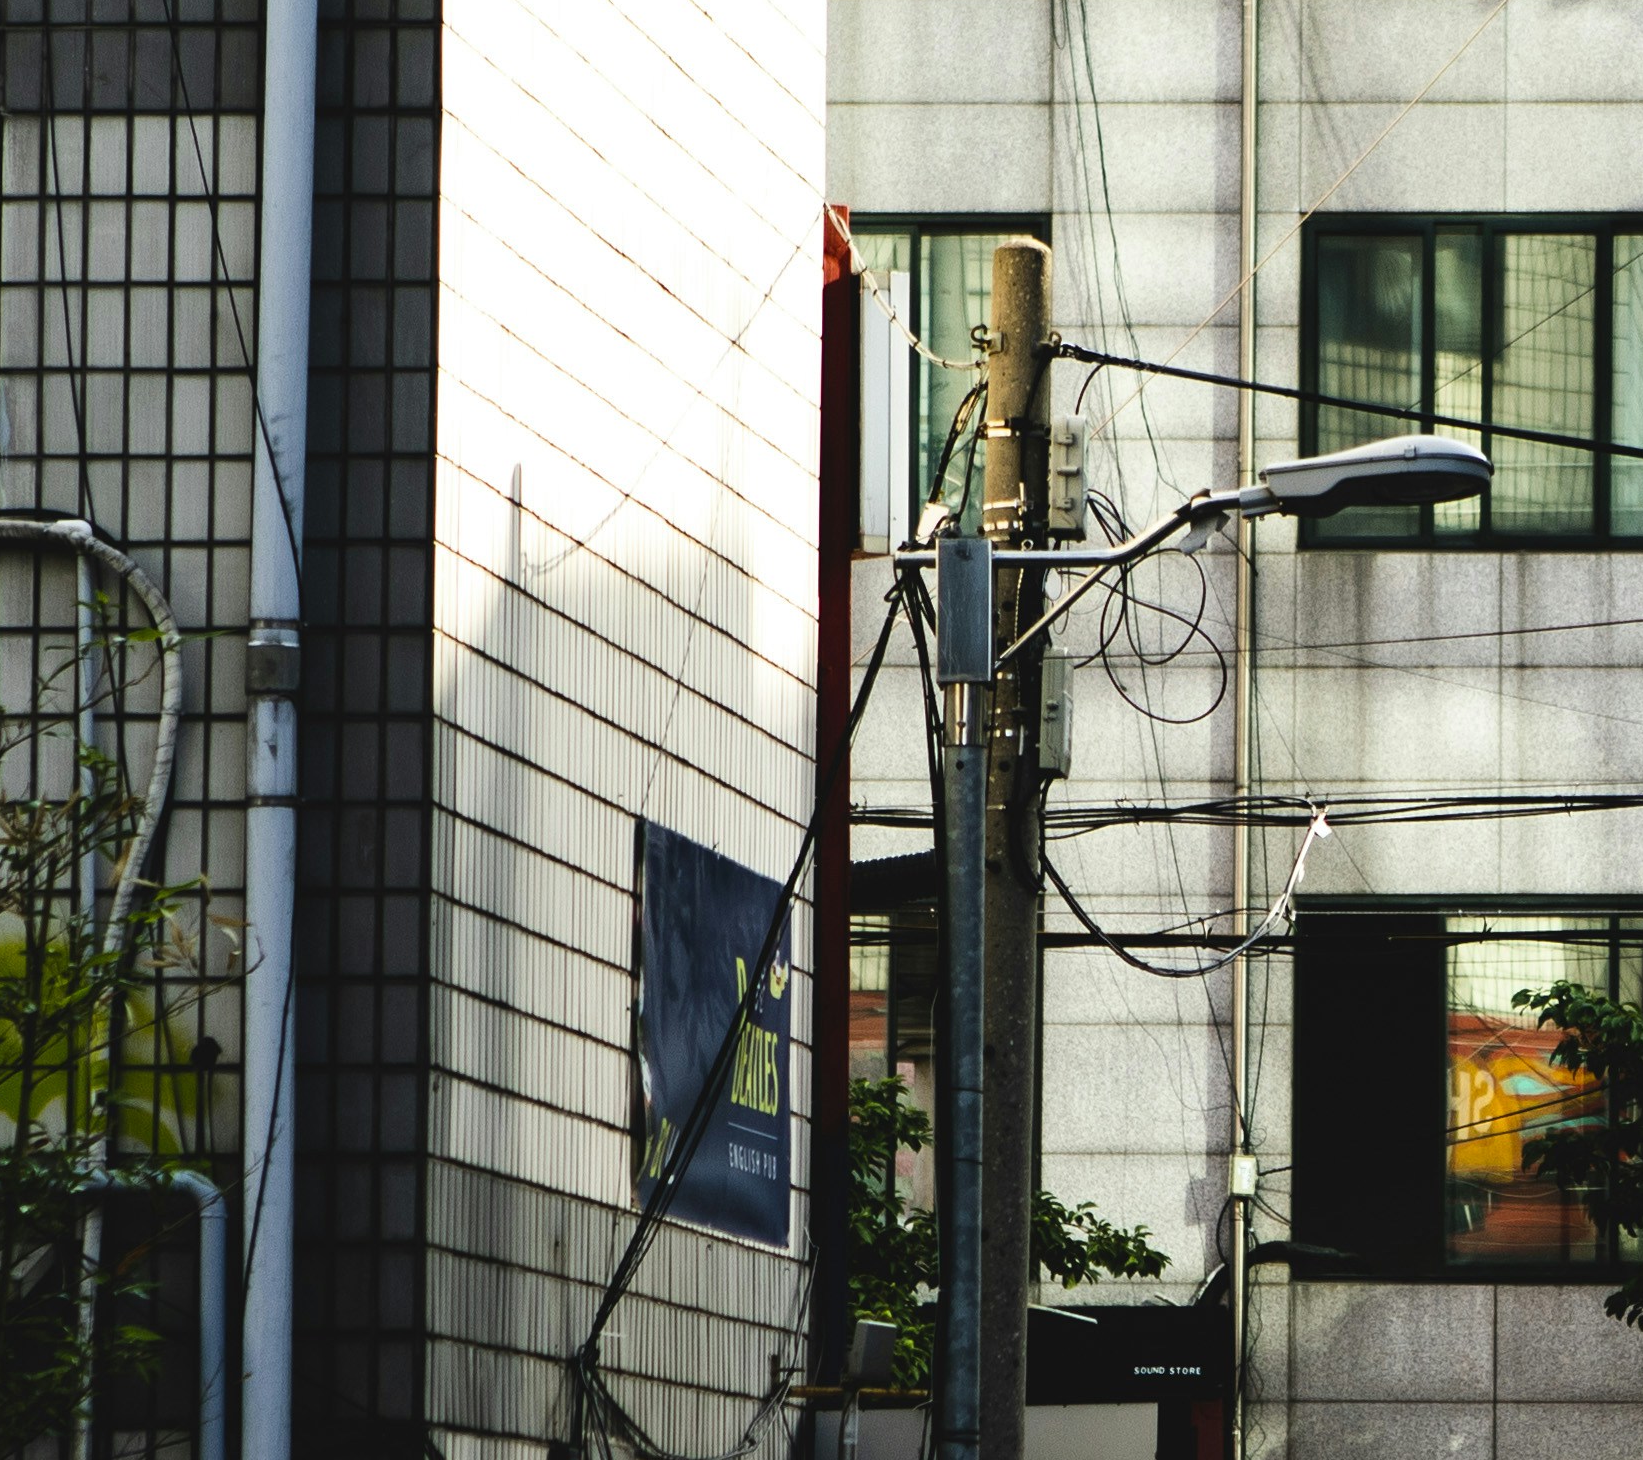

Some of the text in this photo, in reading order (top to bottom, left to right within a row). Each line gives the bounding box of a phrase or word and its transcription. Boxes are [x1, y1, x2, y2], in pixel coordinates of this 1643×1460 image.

[728, 1142, 778, 1181] ENGLISH PUB
[1133, 1366, 1202, 1376] SOUND STORE
